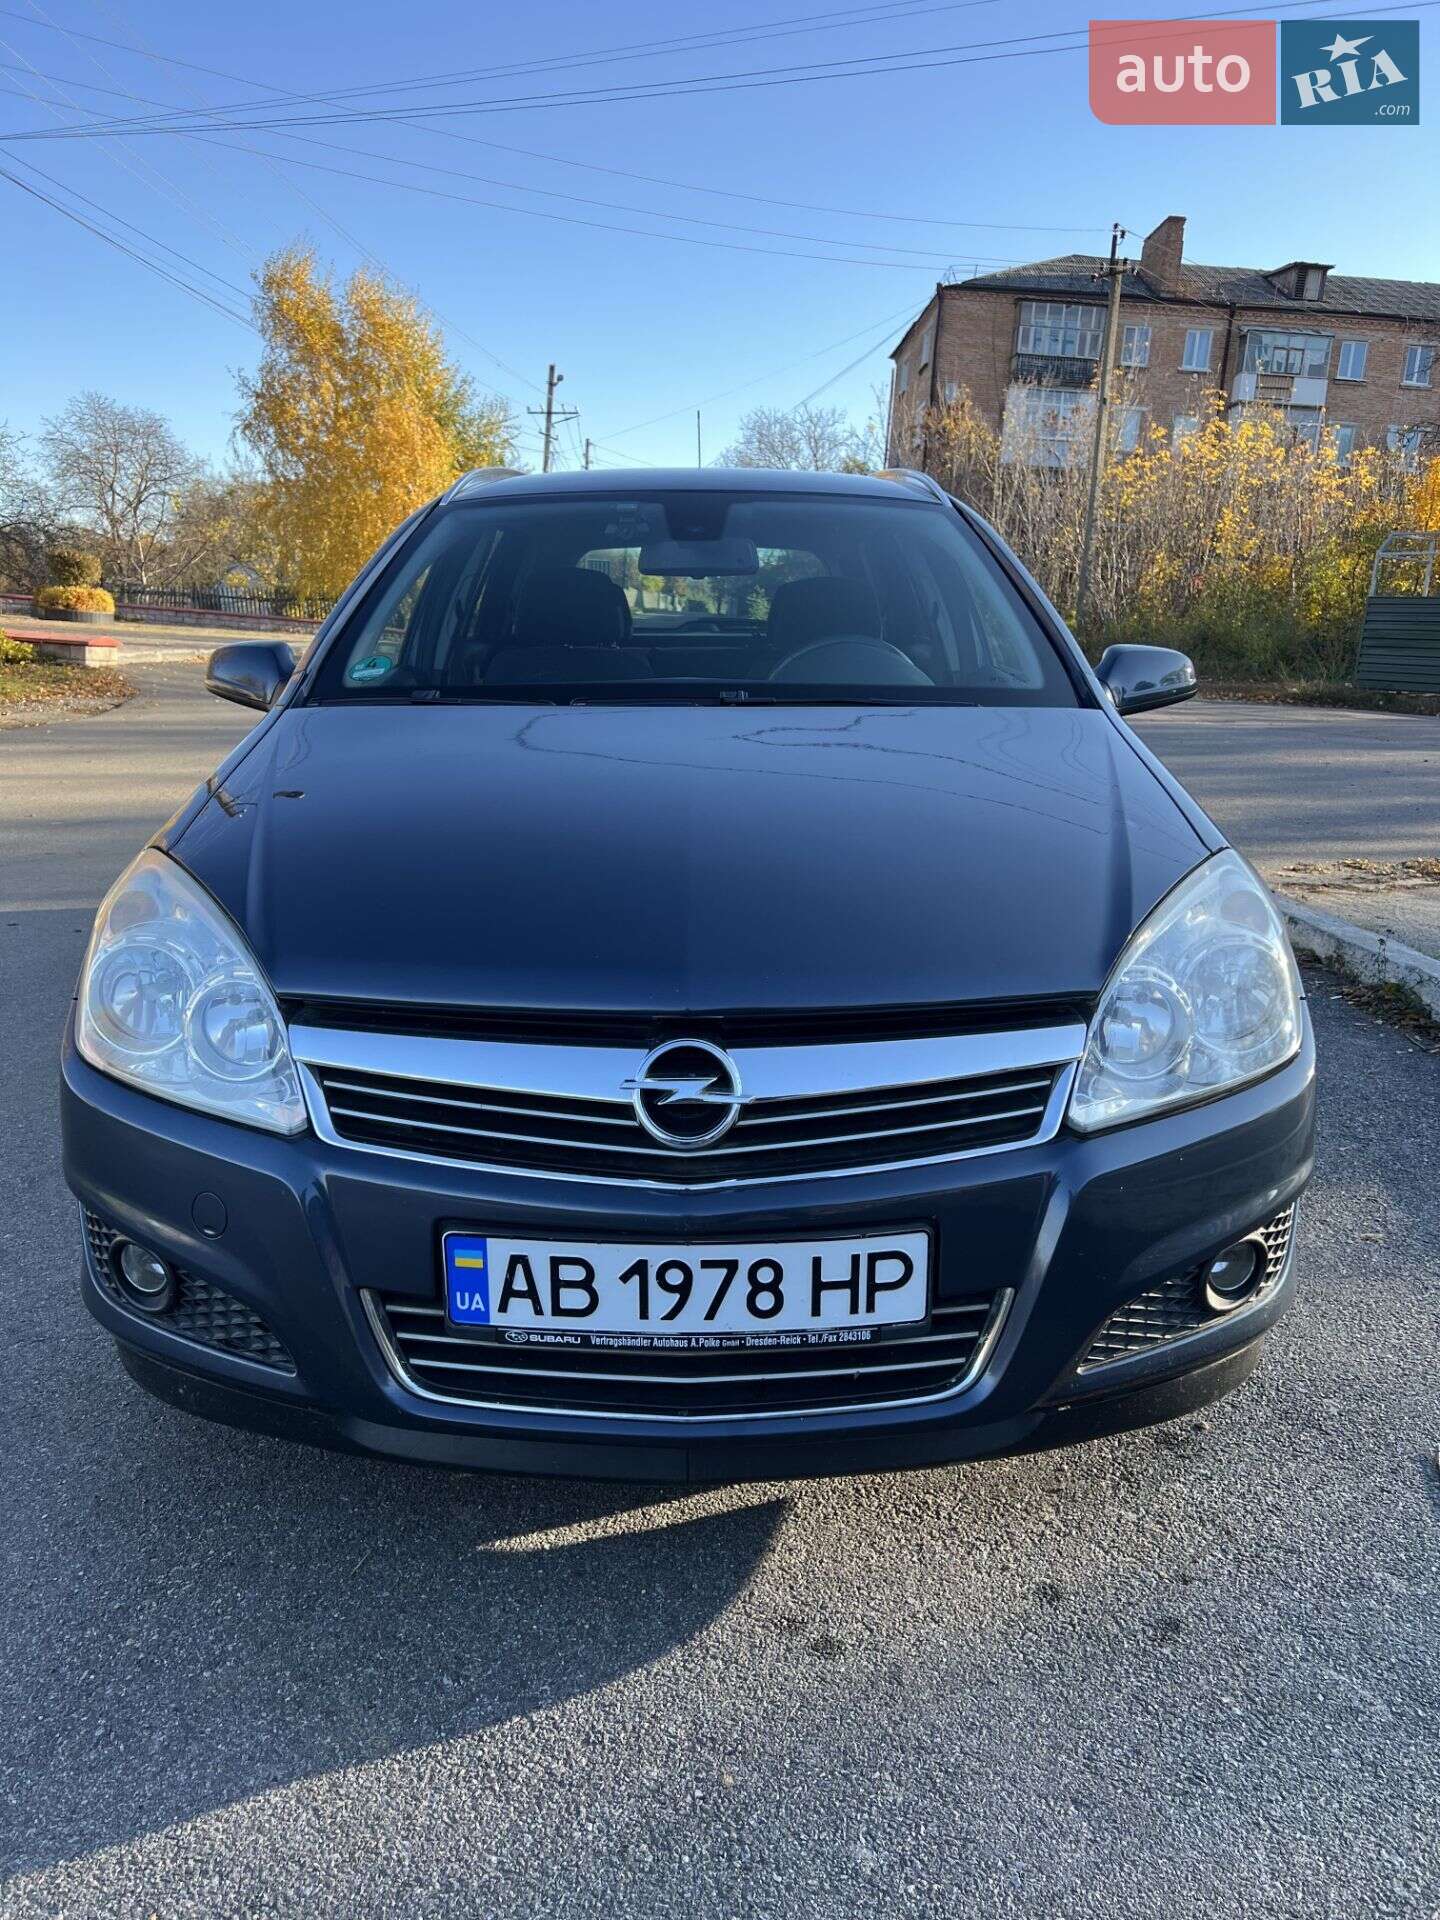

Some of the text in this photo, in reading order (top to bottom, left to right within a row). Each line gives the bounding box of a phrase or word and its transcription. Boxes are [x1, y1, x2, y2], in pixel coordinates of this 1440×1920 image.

[497, 1249, 914, 1321] AB 1978 HP
[456, 1292, 485, 1312] UA
[529, 1333, 581, 1344] SUBARU
[590, 1335, 651, 1348] Vertragshändler
[652, 1337, 688, 1348] Autohaus
